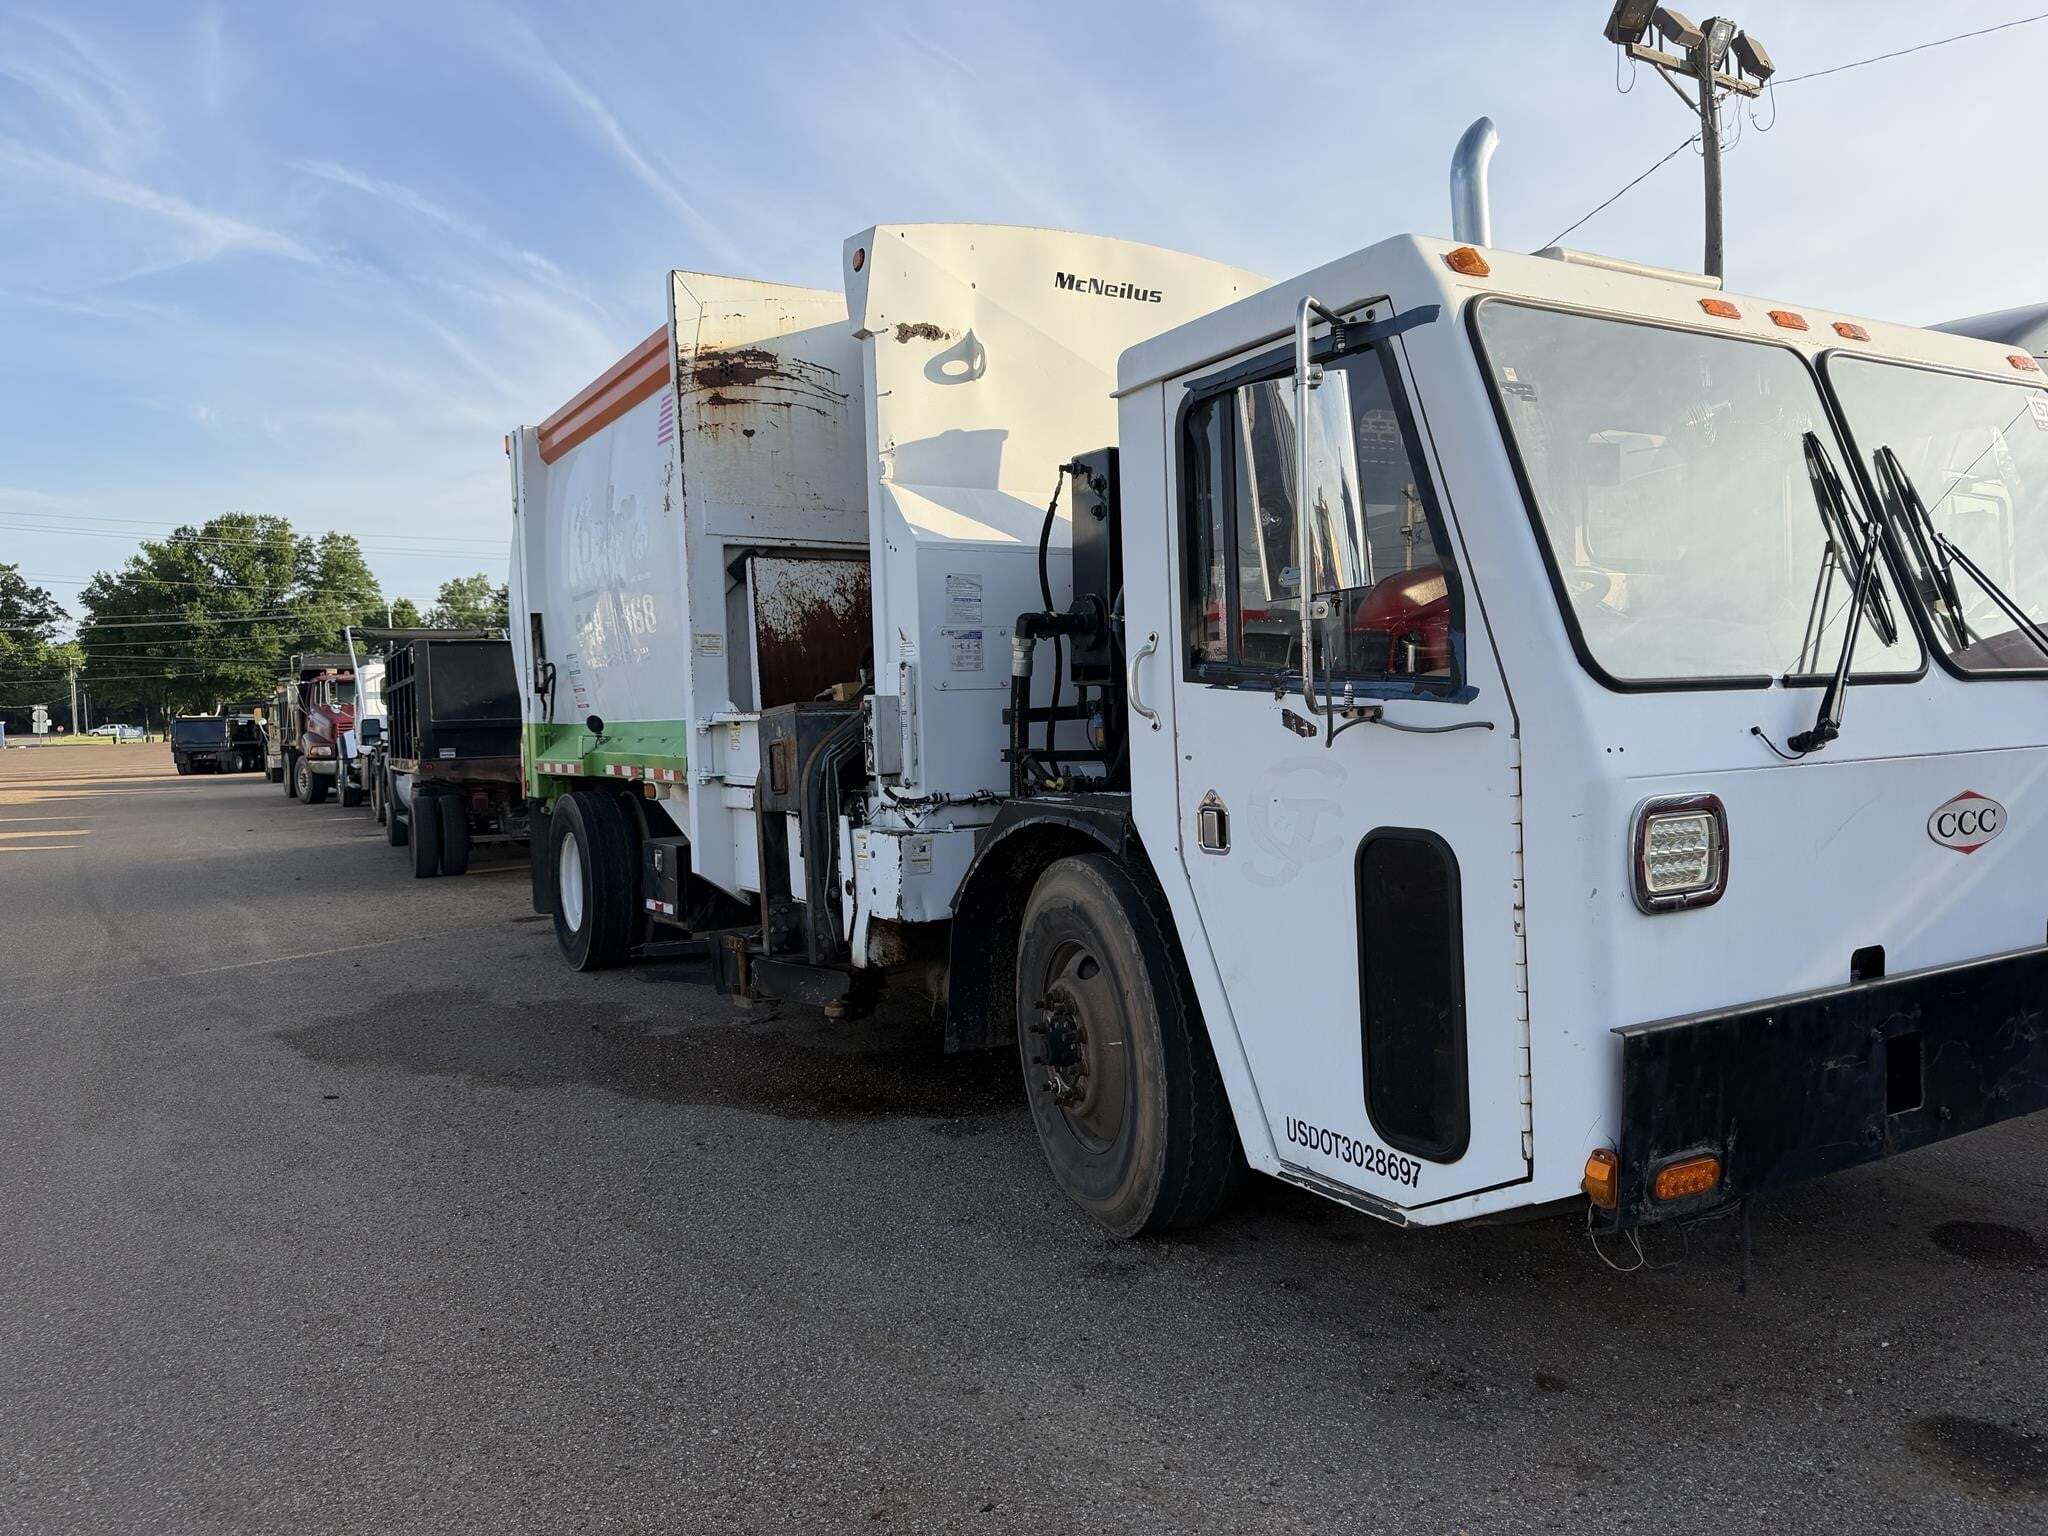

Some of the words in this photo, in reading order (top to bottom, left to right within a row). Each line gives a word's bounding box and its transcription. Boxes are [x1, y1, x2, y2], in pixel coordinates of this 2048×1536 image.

[1055, 271, 1163, 304] McNeilus
[1937, 808, 1997, 838] CCC
[1286, 1116, 1422, 1188] USDOT3028697
